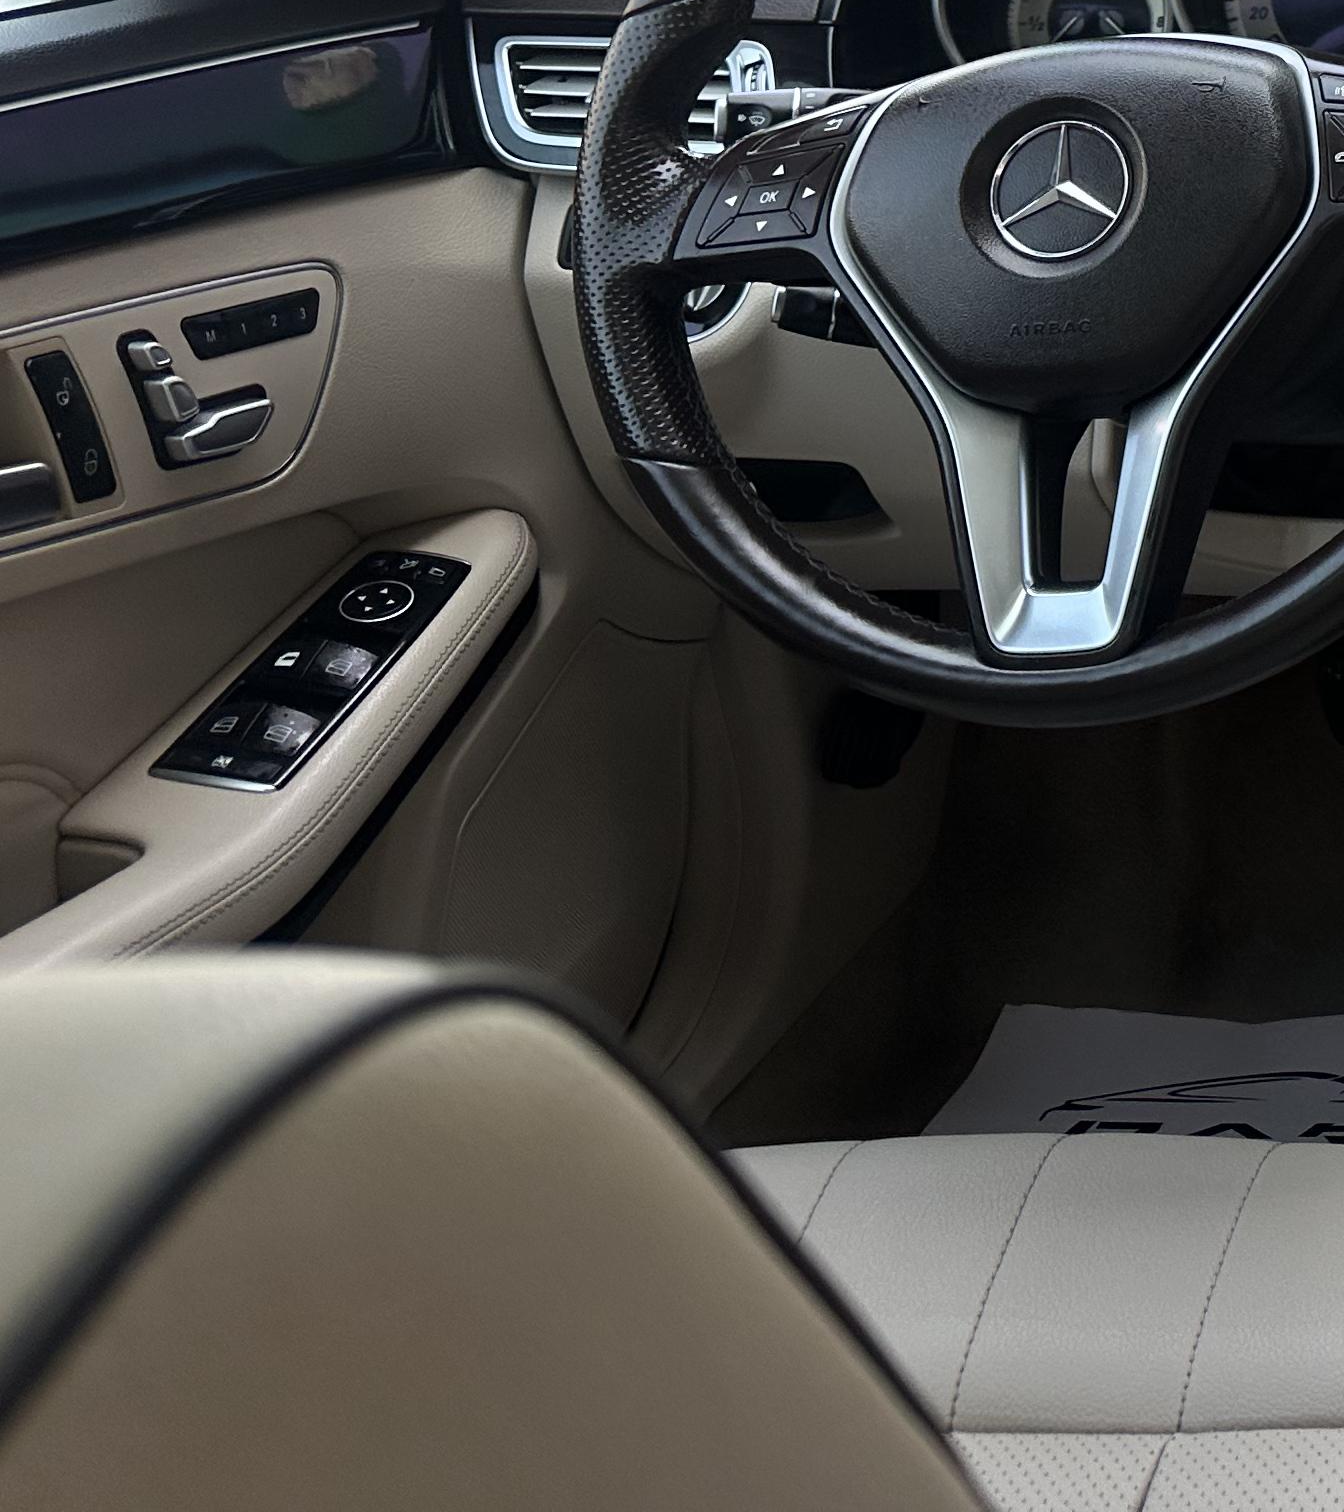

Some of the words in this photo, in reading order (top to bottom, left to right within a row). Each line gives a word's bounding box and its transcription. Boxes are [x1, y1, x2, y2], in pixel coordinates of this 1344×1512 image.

[1250, 6, 1269, 20] 20
[760, 191, 779, 204] OK
[300, 307, 307, 320] 3
[270, 314, 278, 328] 2
[1009, 318, 1092, 337] AIRBAG
[205, 329, 217, 343] M
